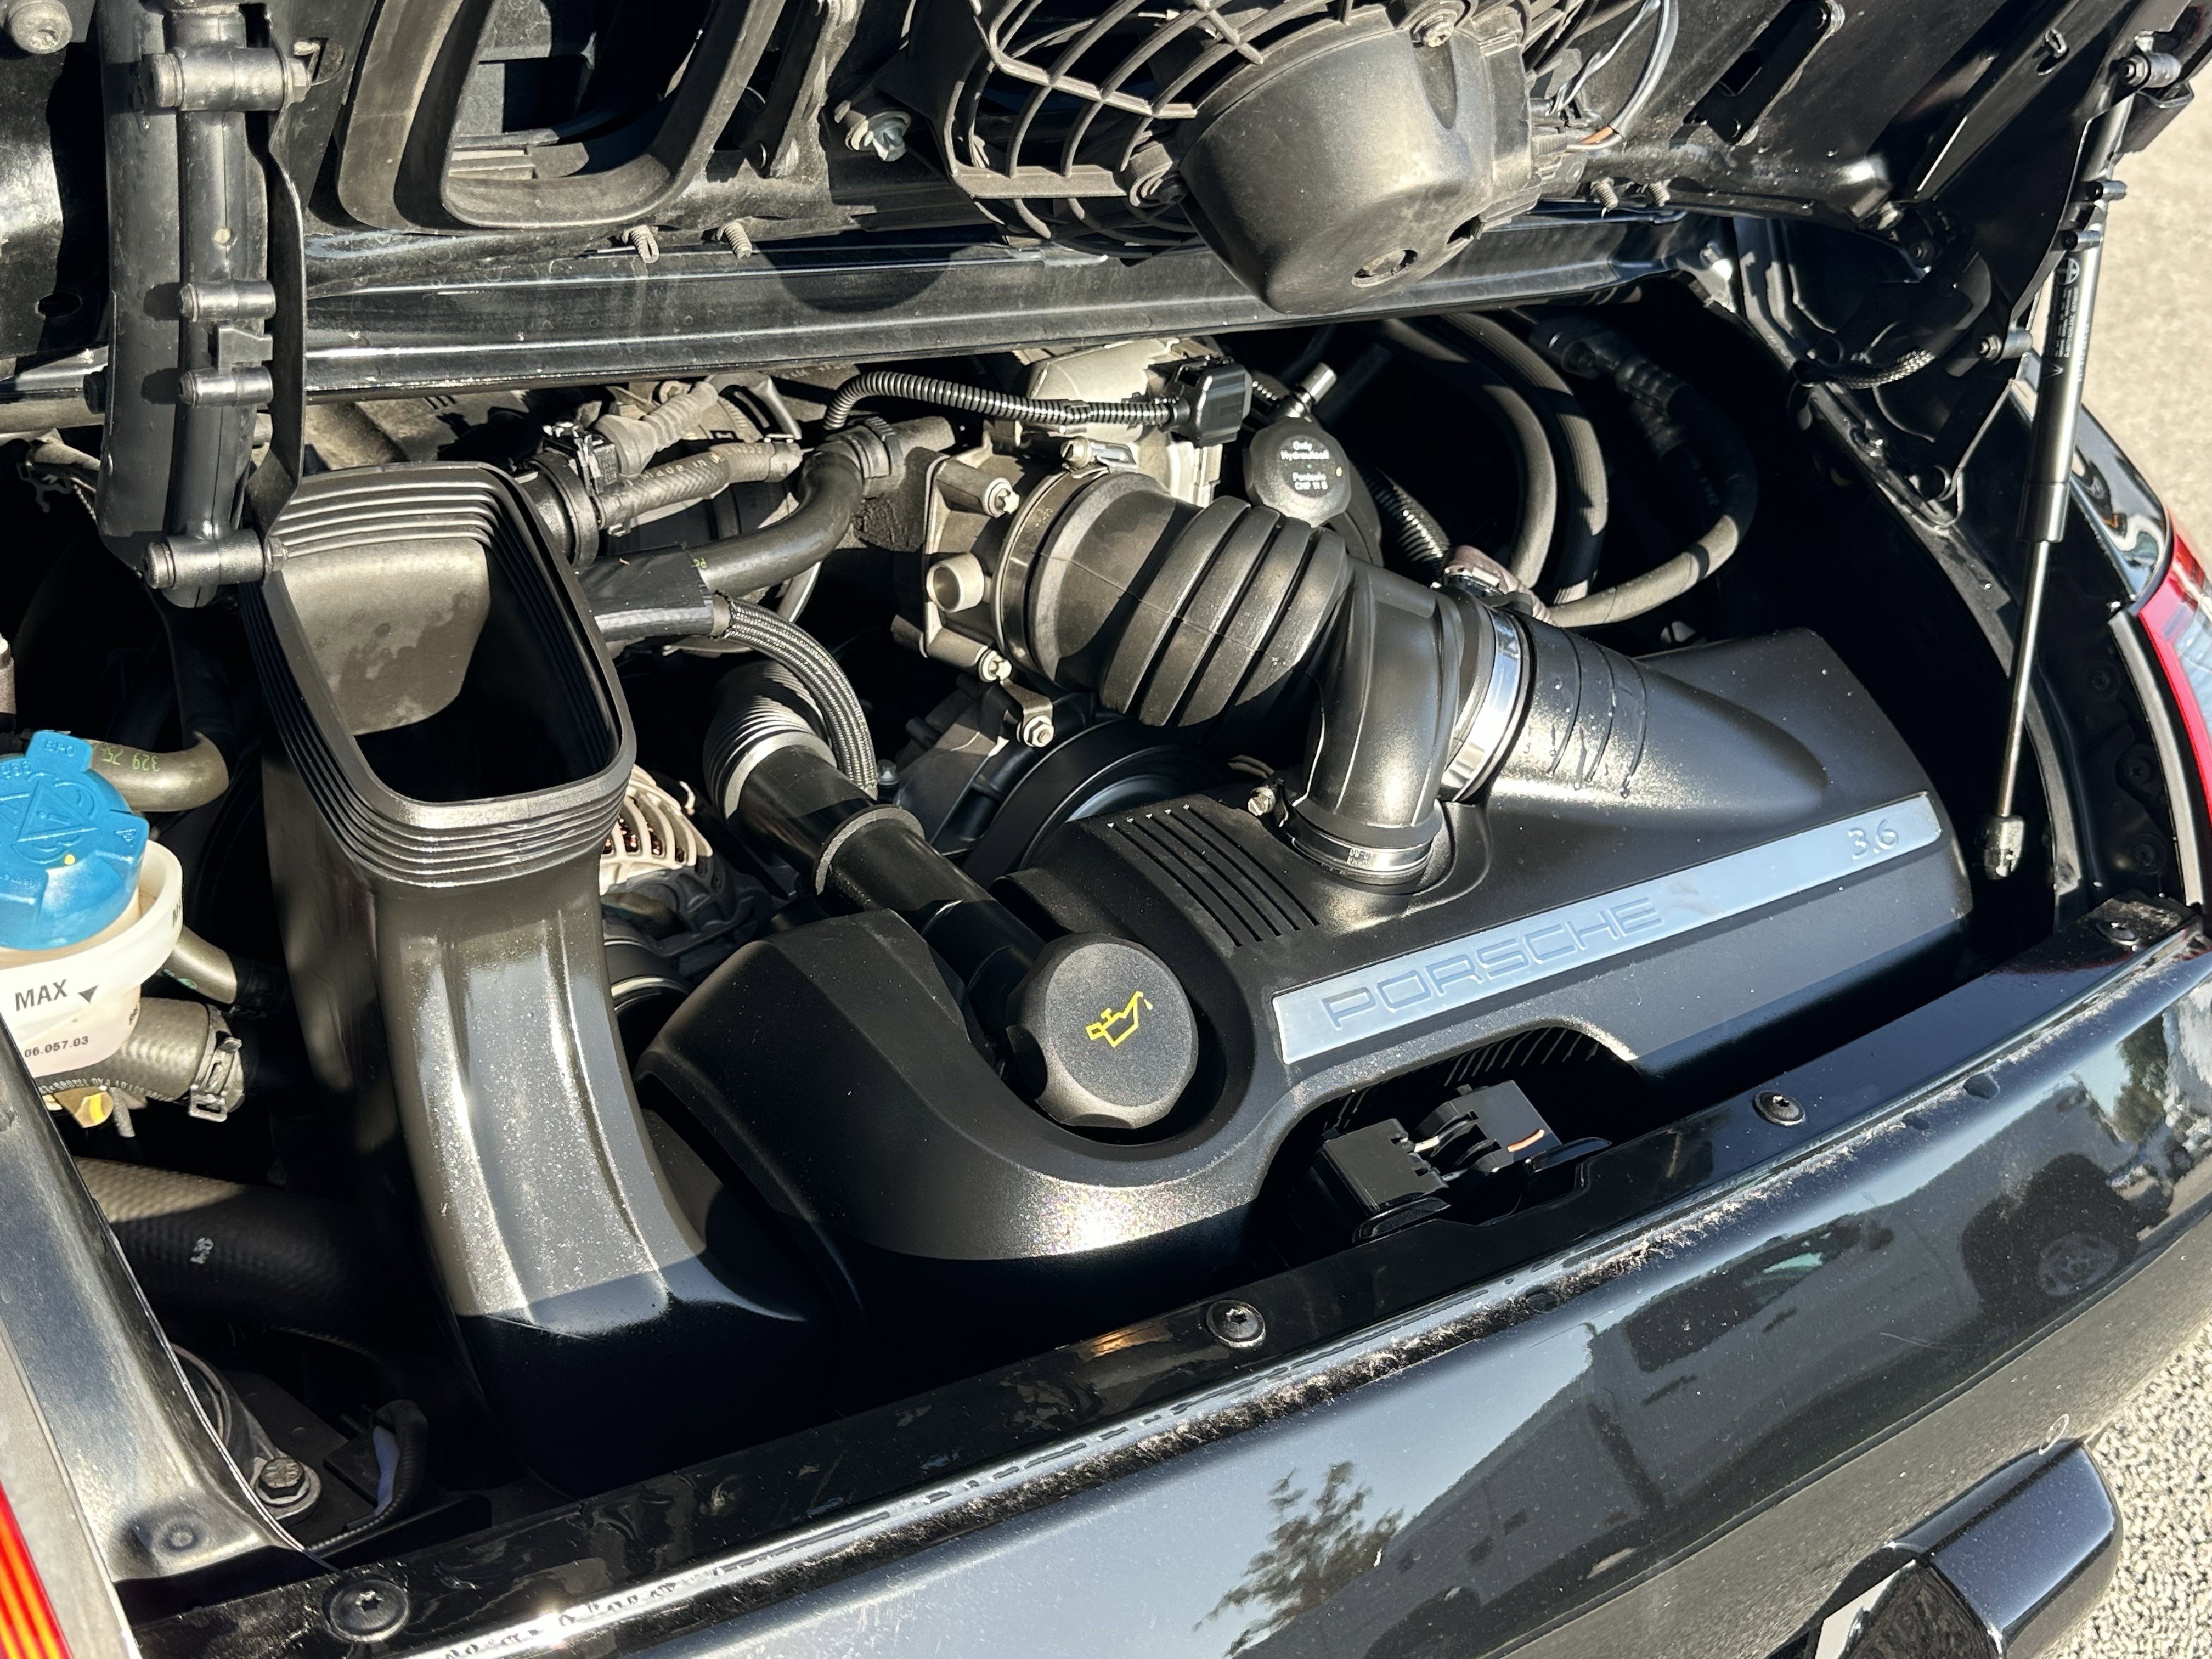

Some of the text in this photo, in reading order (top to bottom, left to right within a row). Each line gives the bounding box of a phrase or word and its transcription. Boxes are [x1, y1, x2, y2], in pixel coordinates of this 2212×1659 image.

[1848, 819, 1899, 860] 3.6
[1322, 897, 1663, 1030] PORSCHE
[15, 979, 68, 1011] MAX
